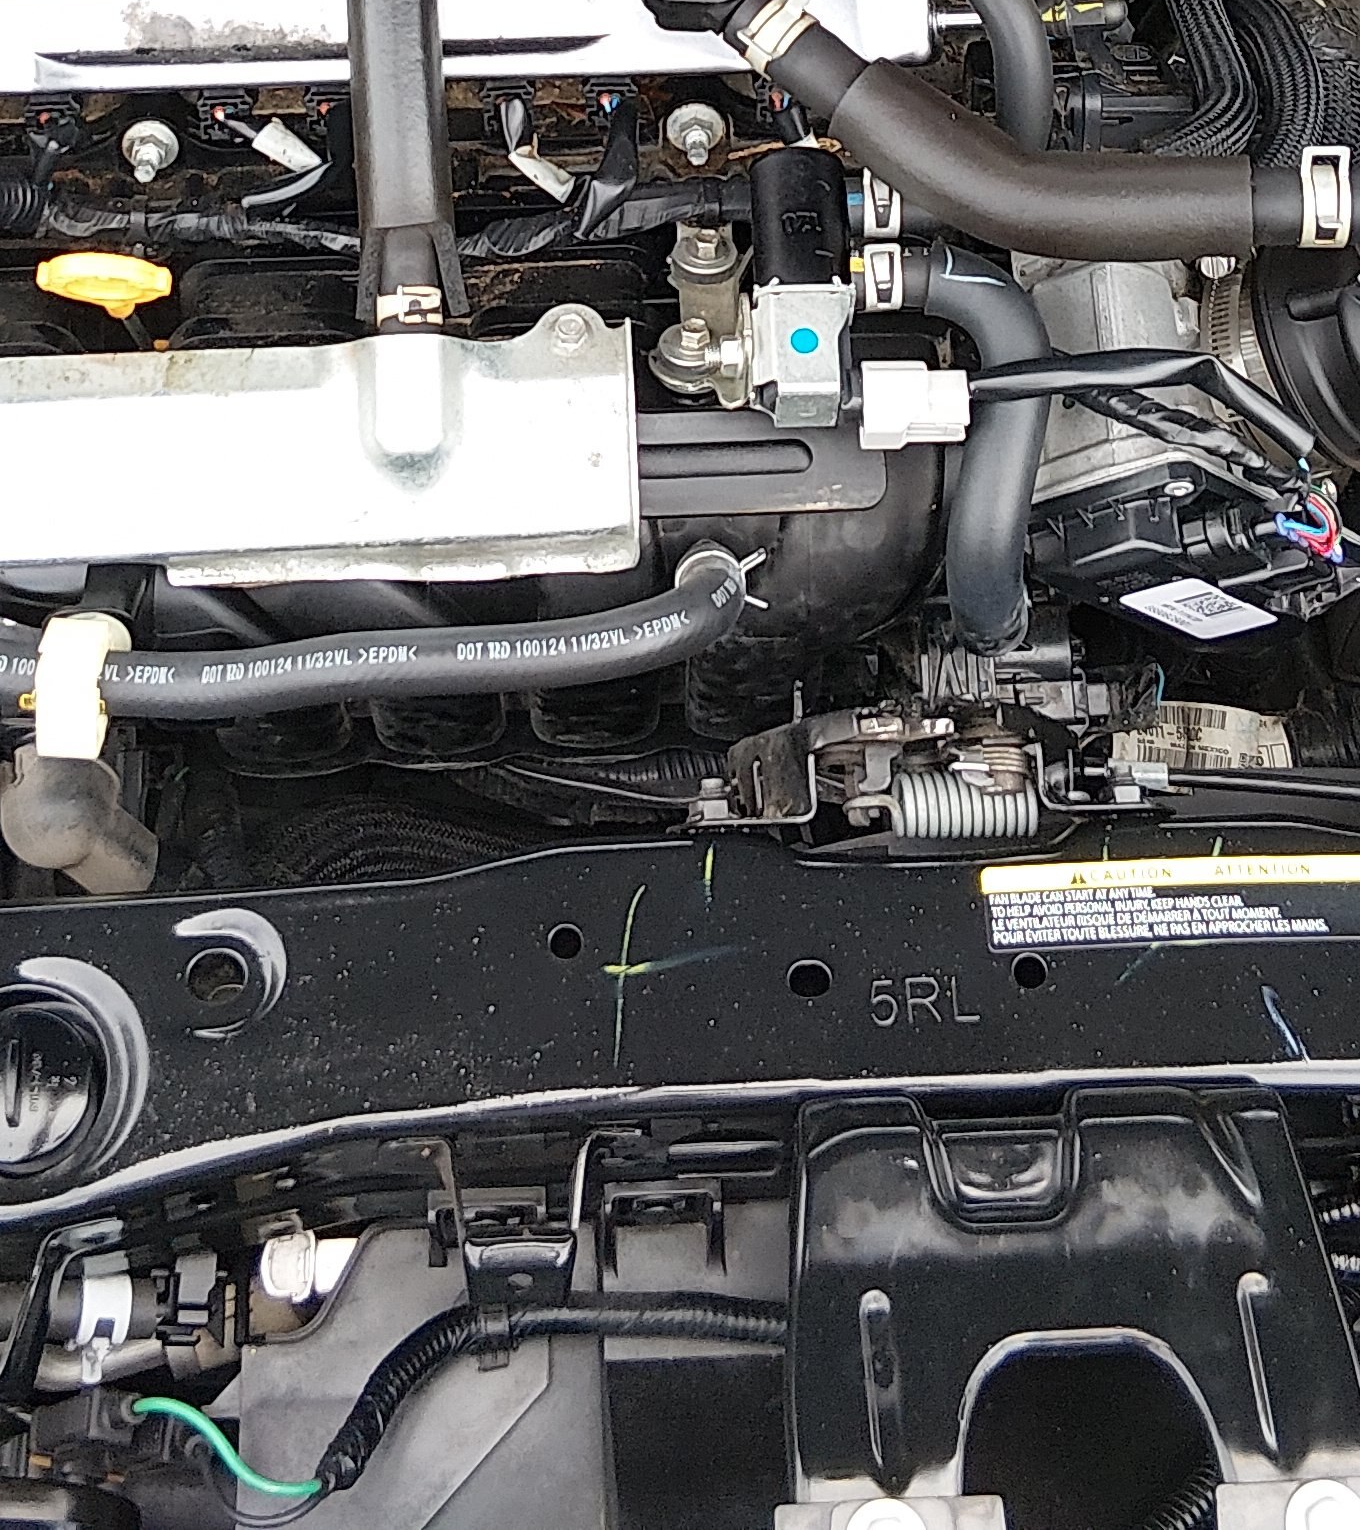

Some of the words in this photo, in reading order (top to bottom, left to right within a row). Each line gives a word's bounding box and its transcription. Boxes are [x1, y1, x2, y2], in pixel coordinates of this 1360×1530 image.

[456, 641, 484, 661] DOT
[515, 636, 567, 658] 100124
[570, 628, 630, 653] 11/32VL
[632, 609, 690, 641] >EPDM<
[11, 656, 37, 676] 100
[201, 664, 223, 684] DOT
[248, 655, 293, 679] 100124
[296, 648, 353, 670] 11/32VL
[358, 645, 418, 665] >EPDM<
[1090, 868, 1172, 882] CAUTION
[1214, 864, 1311, 875] ATTENTION
[989, 893, 1009, 906] FAN
[1010, 892, 1042, 905] BLADE
[1042, 891, 1064, 904] CAN
[1066, 890, 1093, 903] START
[1095, 889, 1108, 902] AT
[1109, 888, 1130, 901] ANY
[991, 906, 1006, 918] TO
[1007, 905, 1031, 917] HELP
[1032, 903, 1063, 917] AVOID
[1064, 902, 1114, 915] PERSONAL
[1151, 899, 1174, 911] KEEP
[1175, 897, 1209, 909] HANDS
[992, 919, 1005, 932] LE
[1006, 915, 1075, 931] VENTILATEUR
[1116, 913, 1132, 925] DE
[1202, 909, 1230, 921] TOUT
[992, 932, 1025, 945] POUR
[1063, 928, 1097, 941] TOUTE
[1154, 924, 1169, 936] NE
[1170, 922, 1190, 935] PAS
[1192, 922, 1207, 934] EN
[1209, 921, 1270, 934] APPROCHER
[1272, 920, 1290, 932] LES
[870, 975, 981, 1028] 5RL
